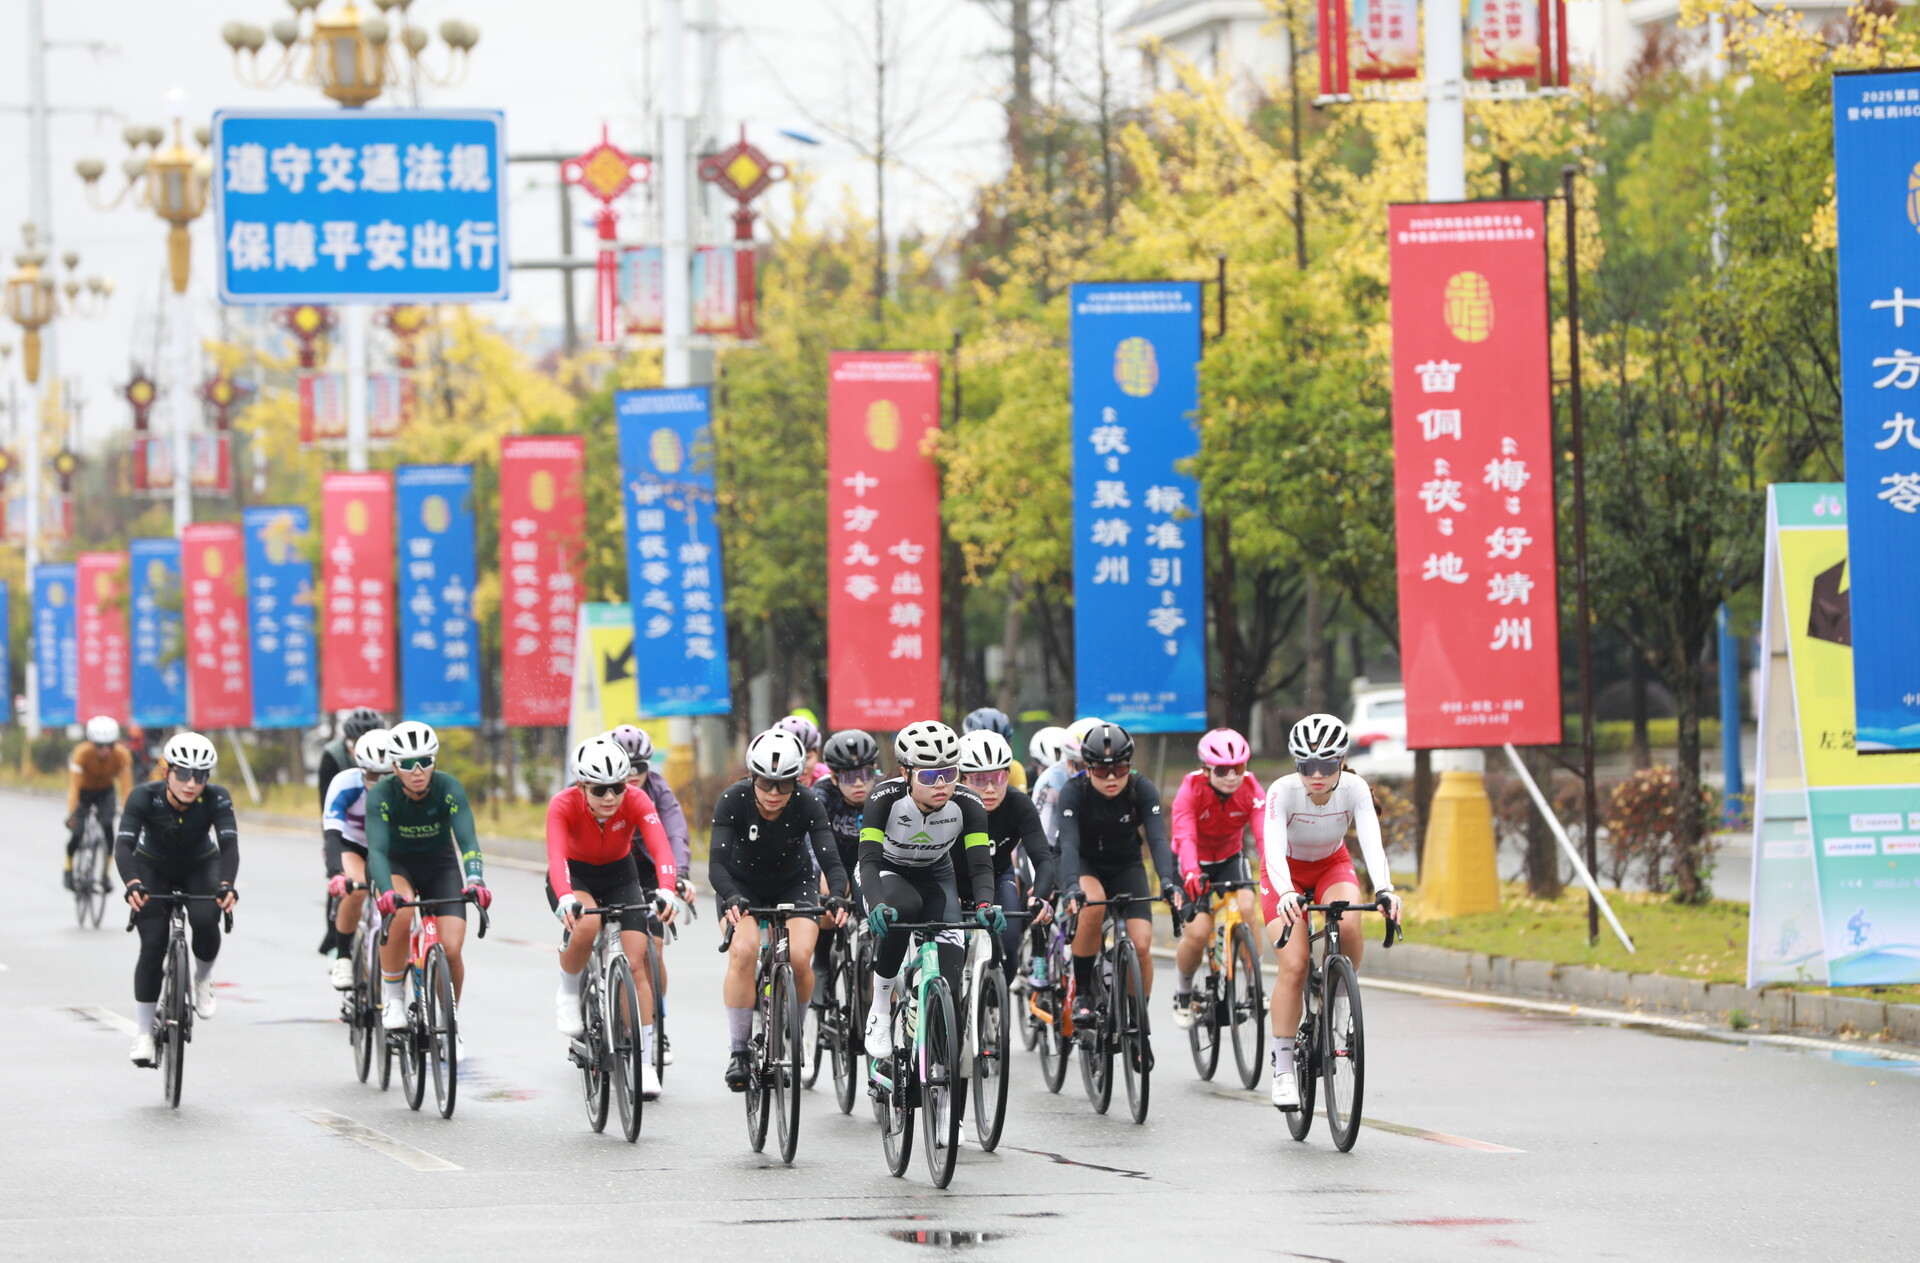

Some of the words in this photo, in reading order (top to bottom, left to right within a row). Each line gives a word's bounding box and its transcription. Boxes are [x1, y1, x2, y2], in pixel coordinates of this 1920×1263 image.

[226, 142, 492, 194] 遵守交通法规
[227, 219, 499, 272] 保障平安出行
[1870, 286, 1920, 514] 十方九苓
[843, 470, 880, 601] 十方九苓
[1903, 693, 1920, 706] 中
[870, 786, 900, 802] Santic
